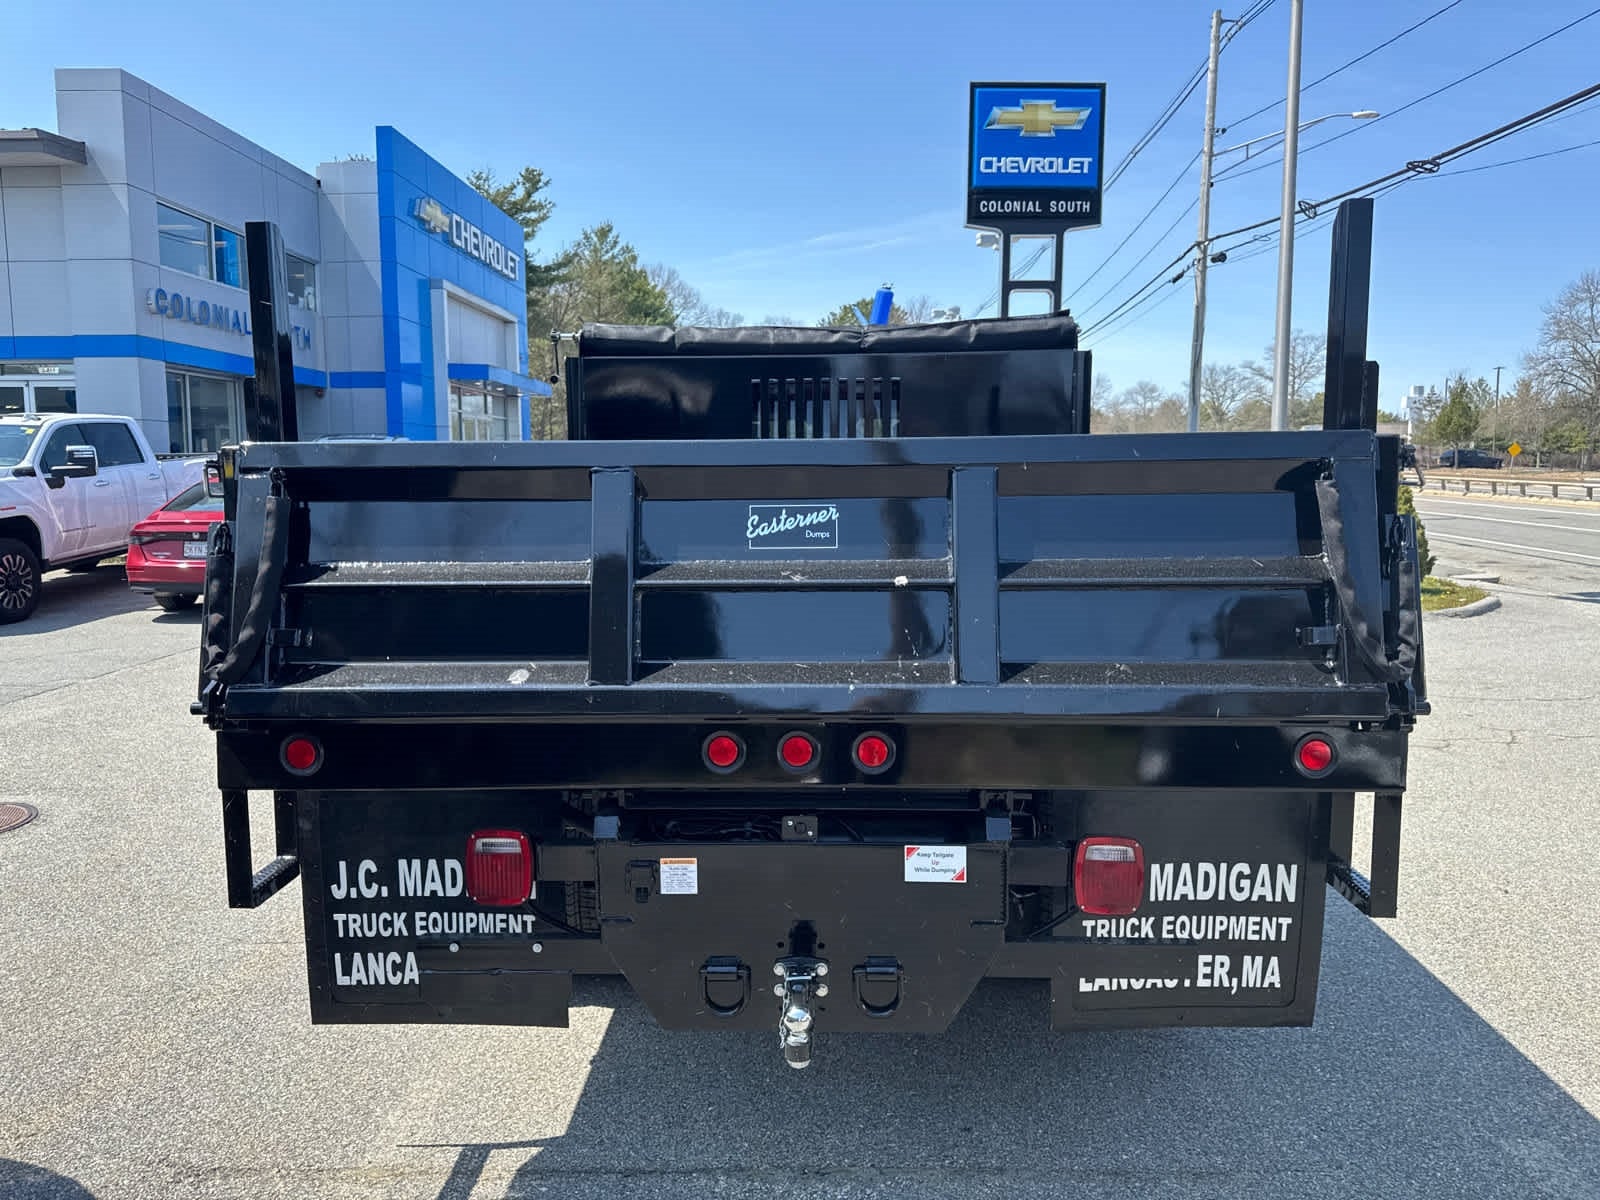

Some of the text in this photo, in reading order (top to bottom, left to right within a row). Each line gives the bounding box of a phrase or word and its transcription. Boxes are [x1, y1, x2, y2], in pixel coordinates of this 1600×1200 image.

[980, 156, 1093, 174] CHEVROLET
[979, 200, 1091, 213] COLONIAL SOUTH
[452, 212, 521, 281] CHEVROLET
[153, 286, 252, 336] COLONIAL
[746, 506, 840, 539] Easterner
[805, 529, 831, 539] Dumps
[330, 858, 389, 900] J.C.
[931, 866, 957, 875] Dumping
[1149, 862, 1298, 903] MADIGAN
[333, 911, 537, 938] TRUCK EQUIPMENT
[1081, 914, 1293, 942] TRUCK EQUIPMENT
